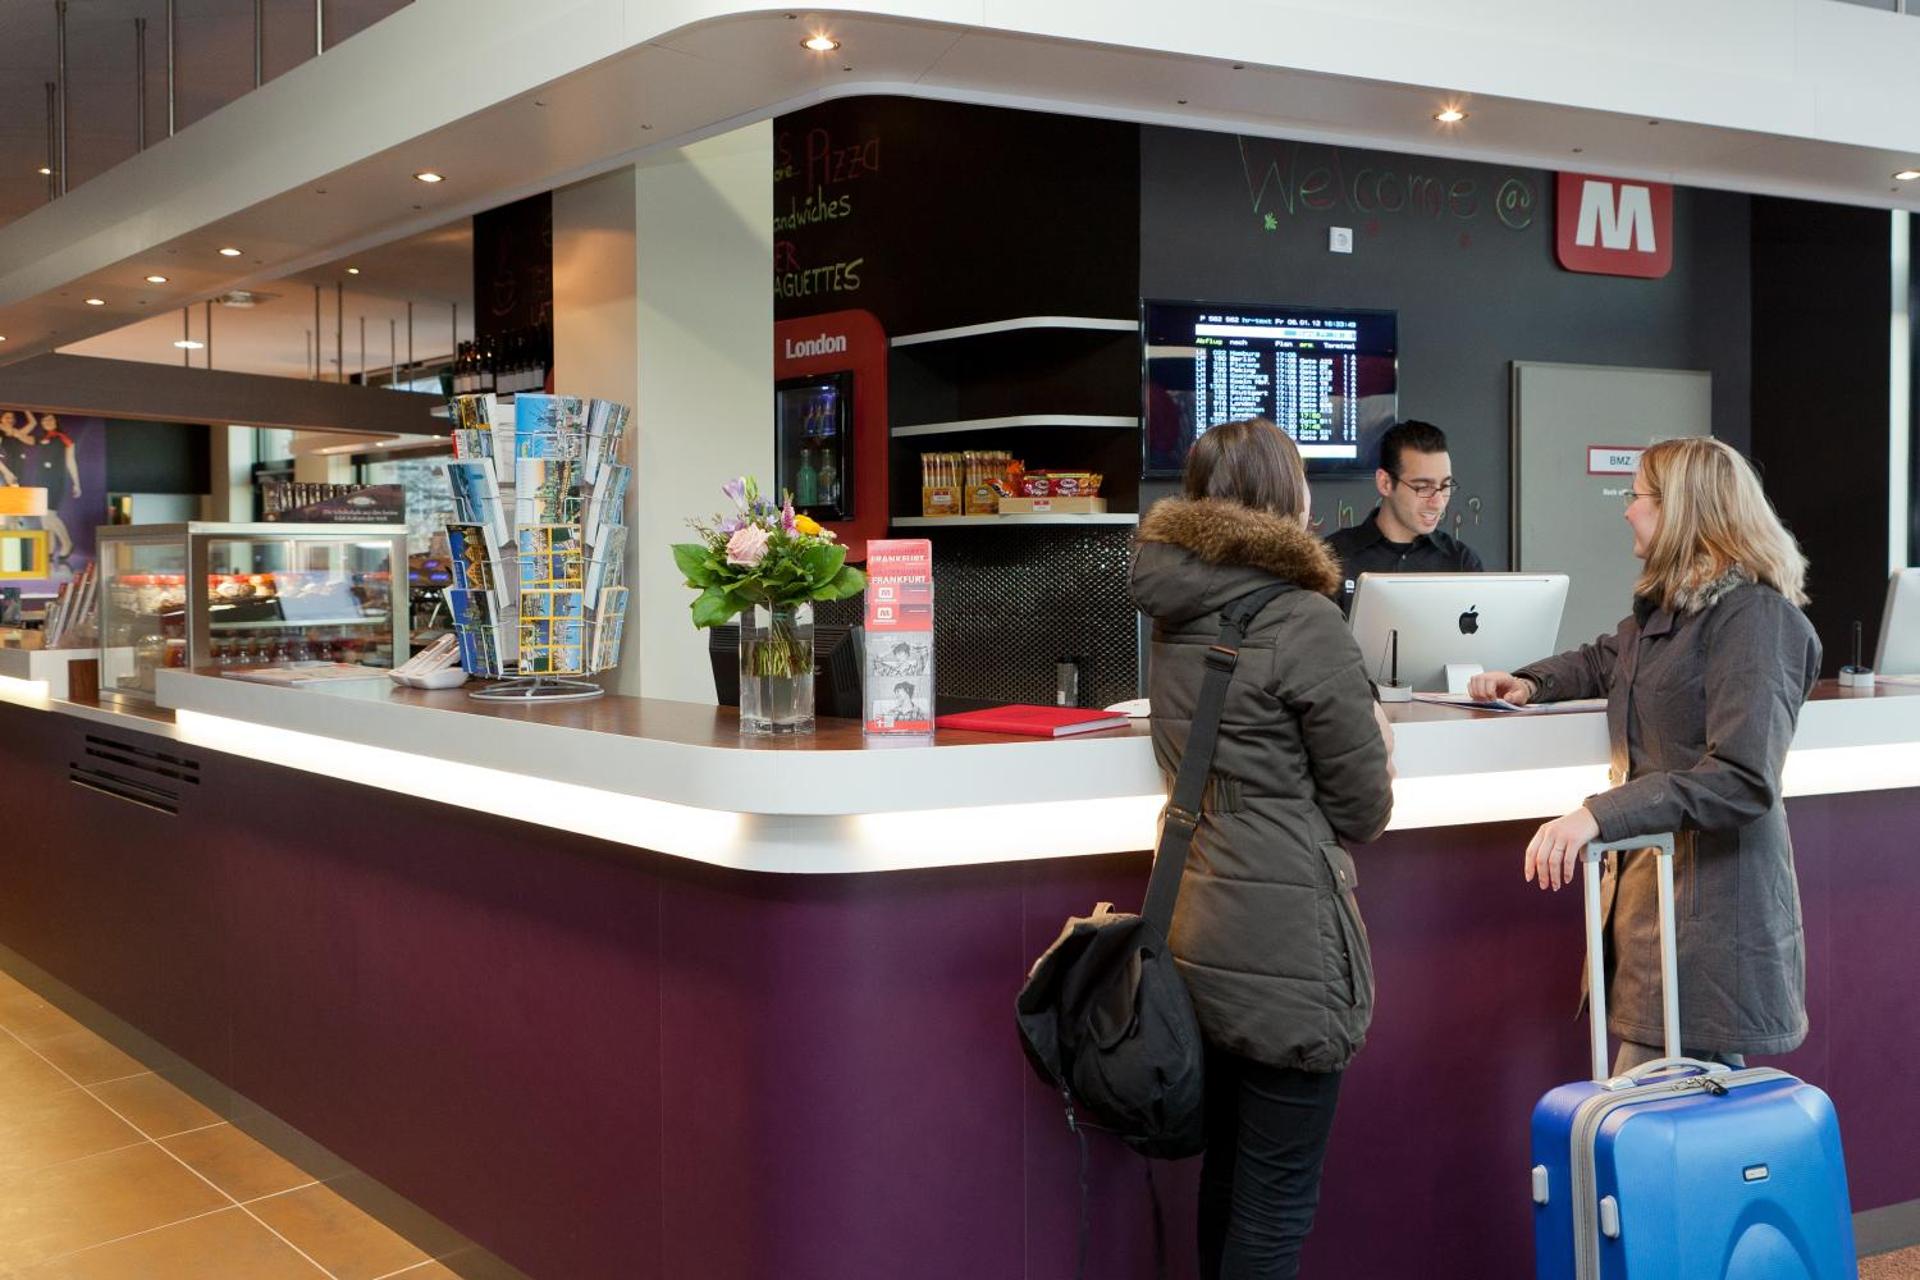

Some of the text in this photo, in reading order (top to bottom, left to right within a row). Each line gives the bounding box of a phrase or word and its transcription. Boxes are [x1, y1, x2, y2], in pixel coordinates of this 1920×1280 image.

[1237, 133, 1480, 218] Welcome
[773, 184, 852, 232] andwiches
[1575, 180, 1657, 253] M
[773, 257, 864, 299] AGUETTES
[785, 332, 847, 360] London
[872, 575, 926, 584] FRANKFURT
